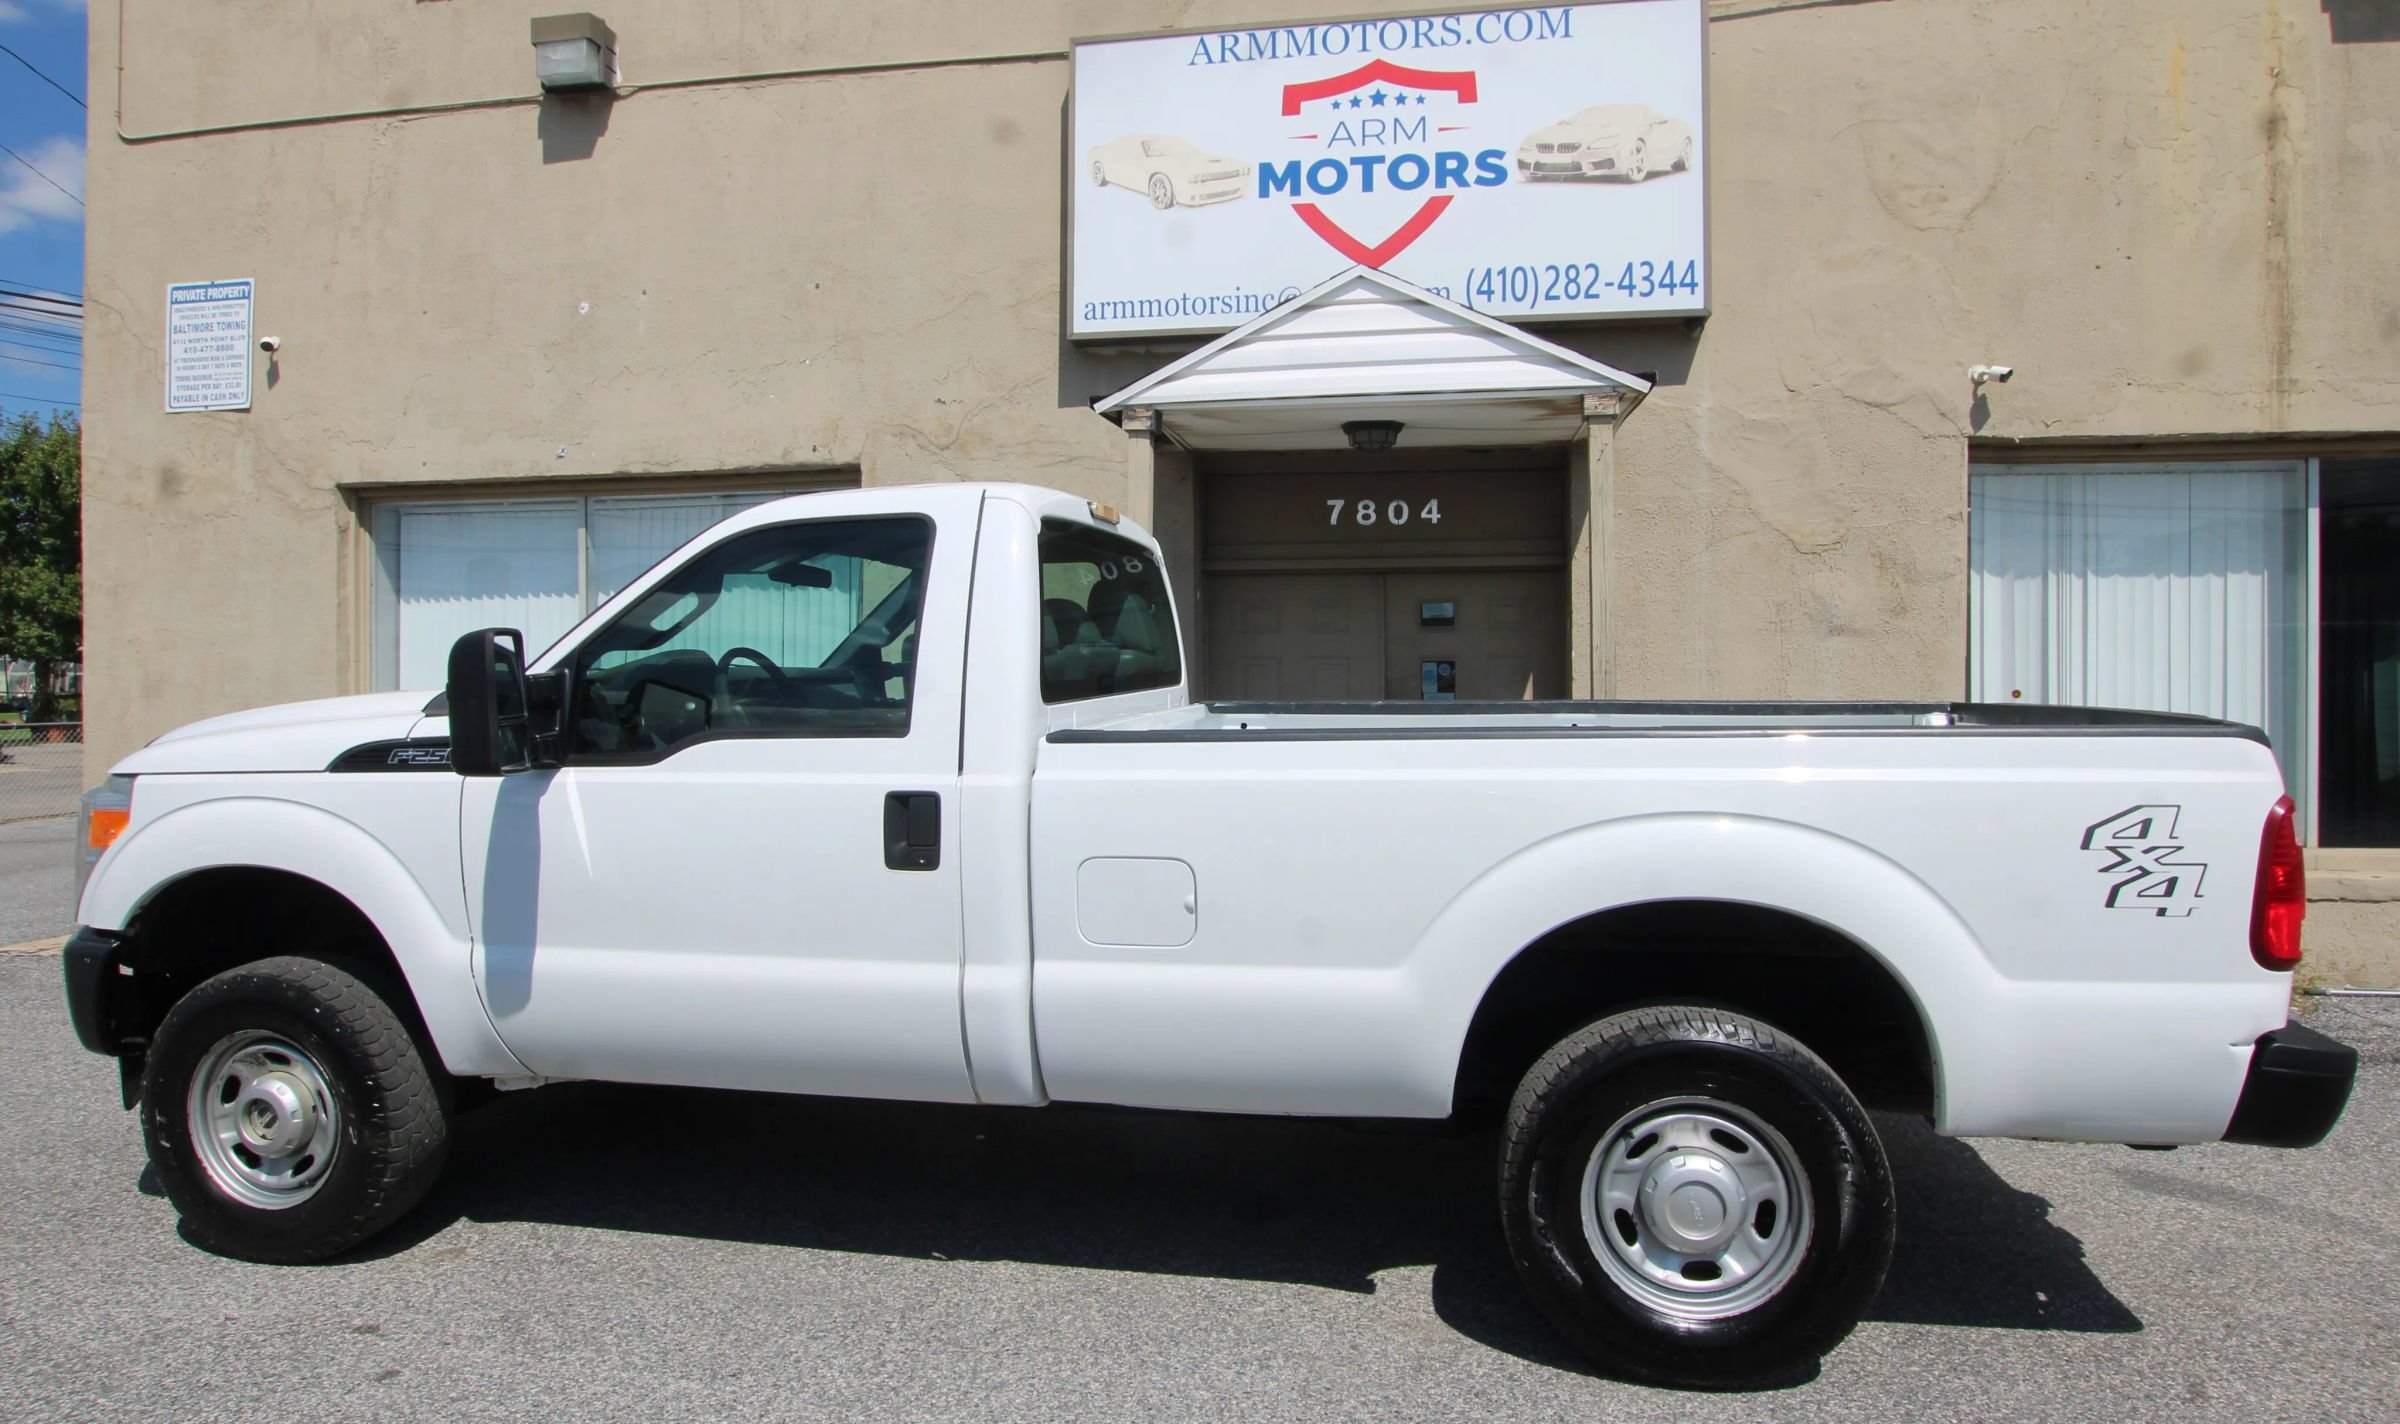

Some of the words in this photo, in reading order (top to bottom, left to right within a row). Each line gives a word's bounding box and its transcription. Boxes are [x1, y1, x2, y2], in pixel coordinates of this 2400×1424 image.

[1187, 7, 1573, 66] ARMMOTORS.COM
[1327, 115, 1428, 149] ARM
[1258, 148, 1509, 199] MOTORS
[173, 289, 206, 302] PRIVATE
[207, 286, 250, 299] PROPERTY
[1466, 259, 1699, 310] (410)282-4344
[173, 322, 215, 335] BALTIMORE
[216, 320, 246, 332] TOWING
[173, 394, 200, 403] PAYABLE
[202, 394, 208, 402] IN
[210, 392, 227, 401] CASH
[228, 392, 245, 400] ONLY
[1326, 498, 1442, 526] 7804
